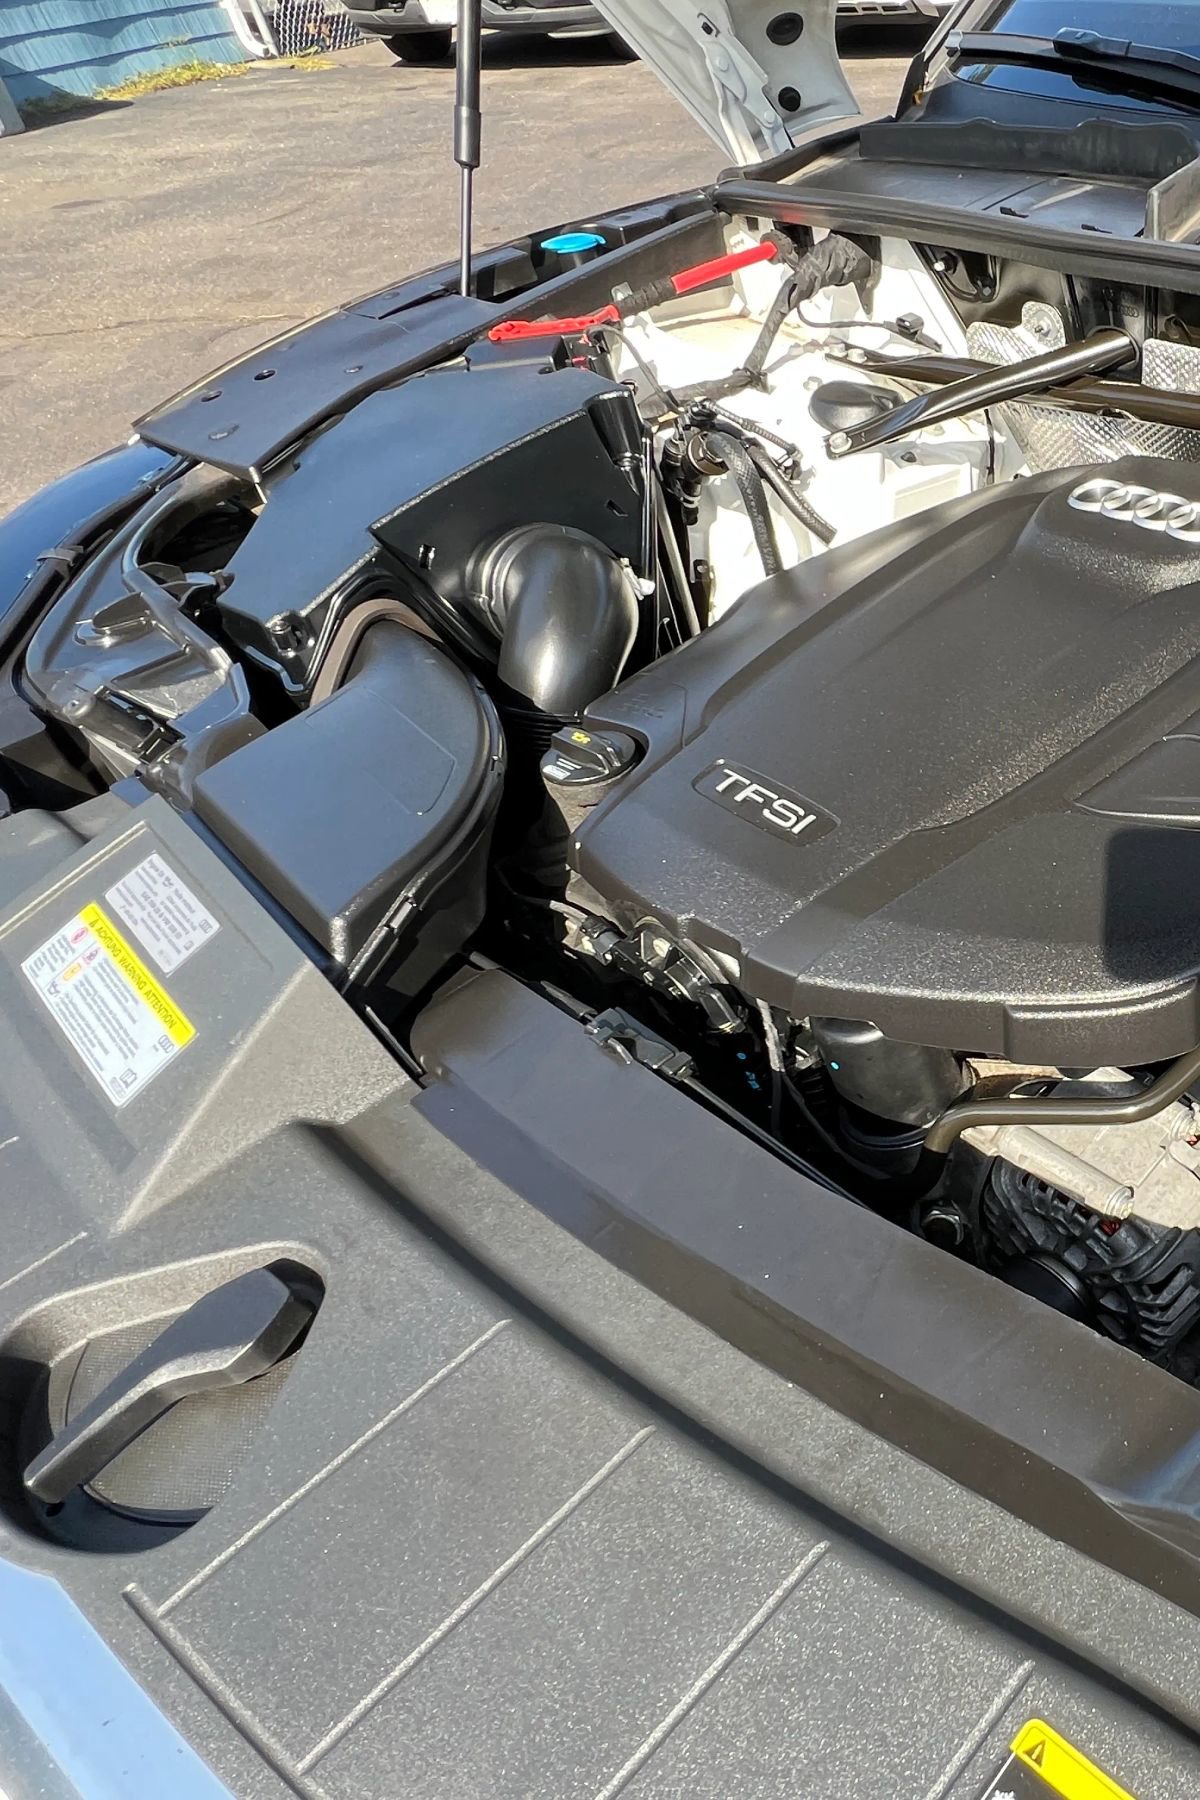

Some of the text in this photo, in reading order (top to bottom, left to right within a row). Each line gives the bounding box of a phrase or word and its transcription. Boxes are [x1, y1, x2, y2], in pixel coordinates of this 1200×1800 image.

[715, 768, 817, 835] TFSI
[95, 926, 177, 1030] ACHTUNG WARNING ATTENTION
